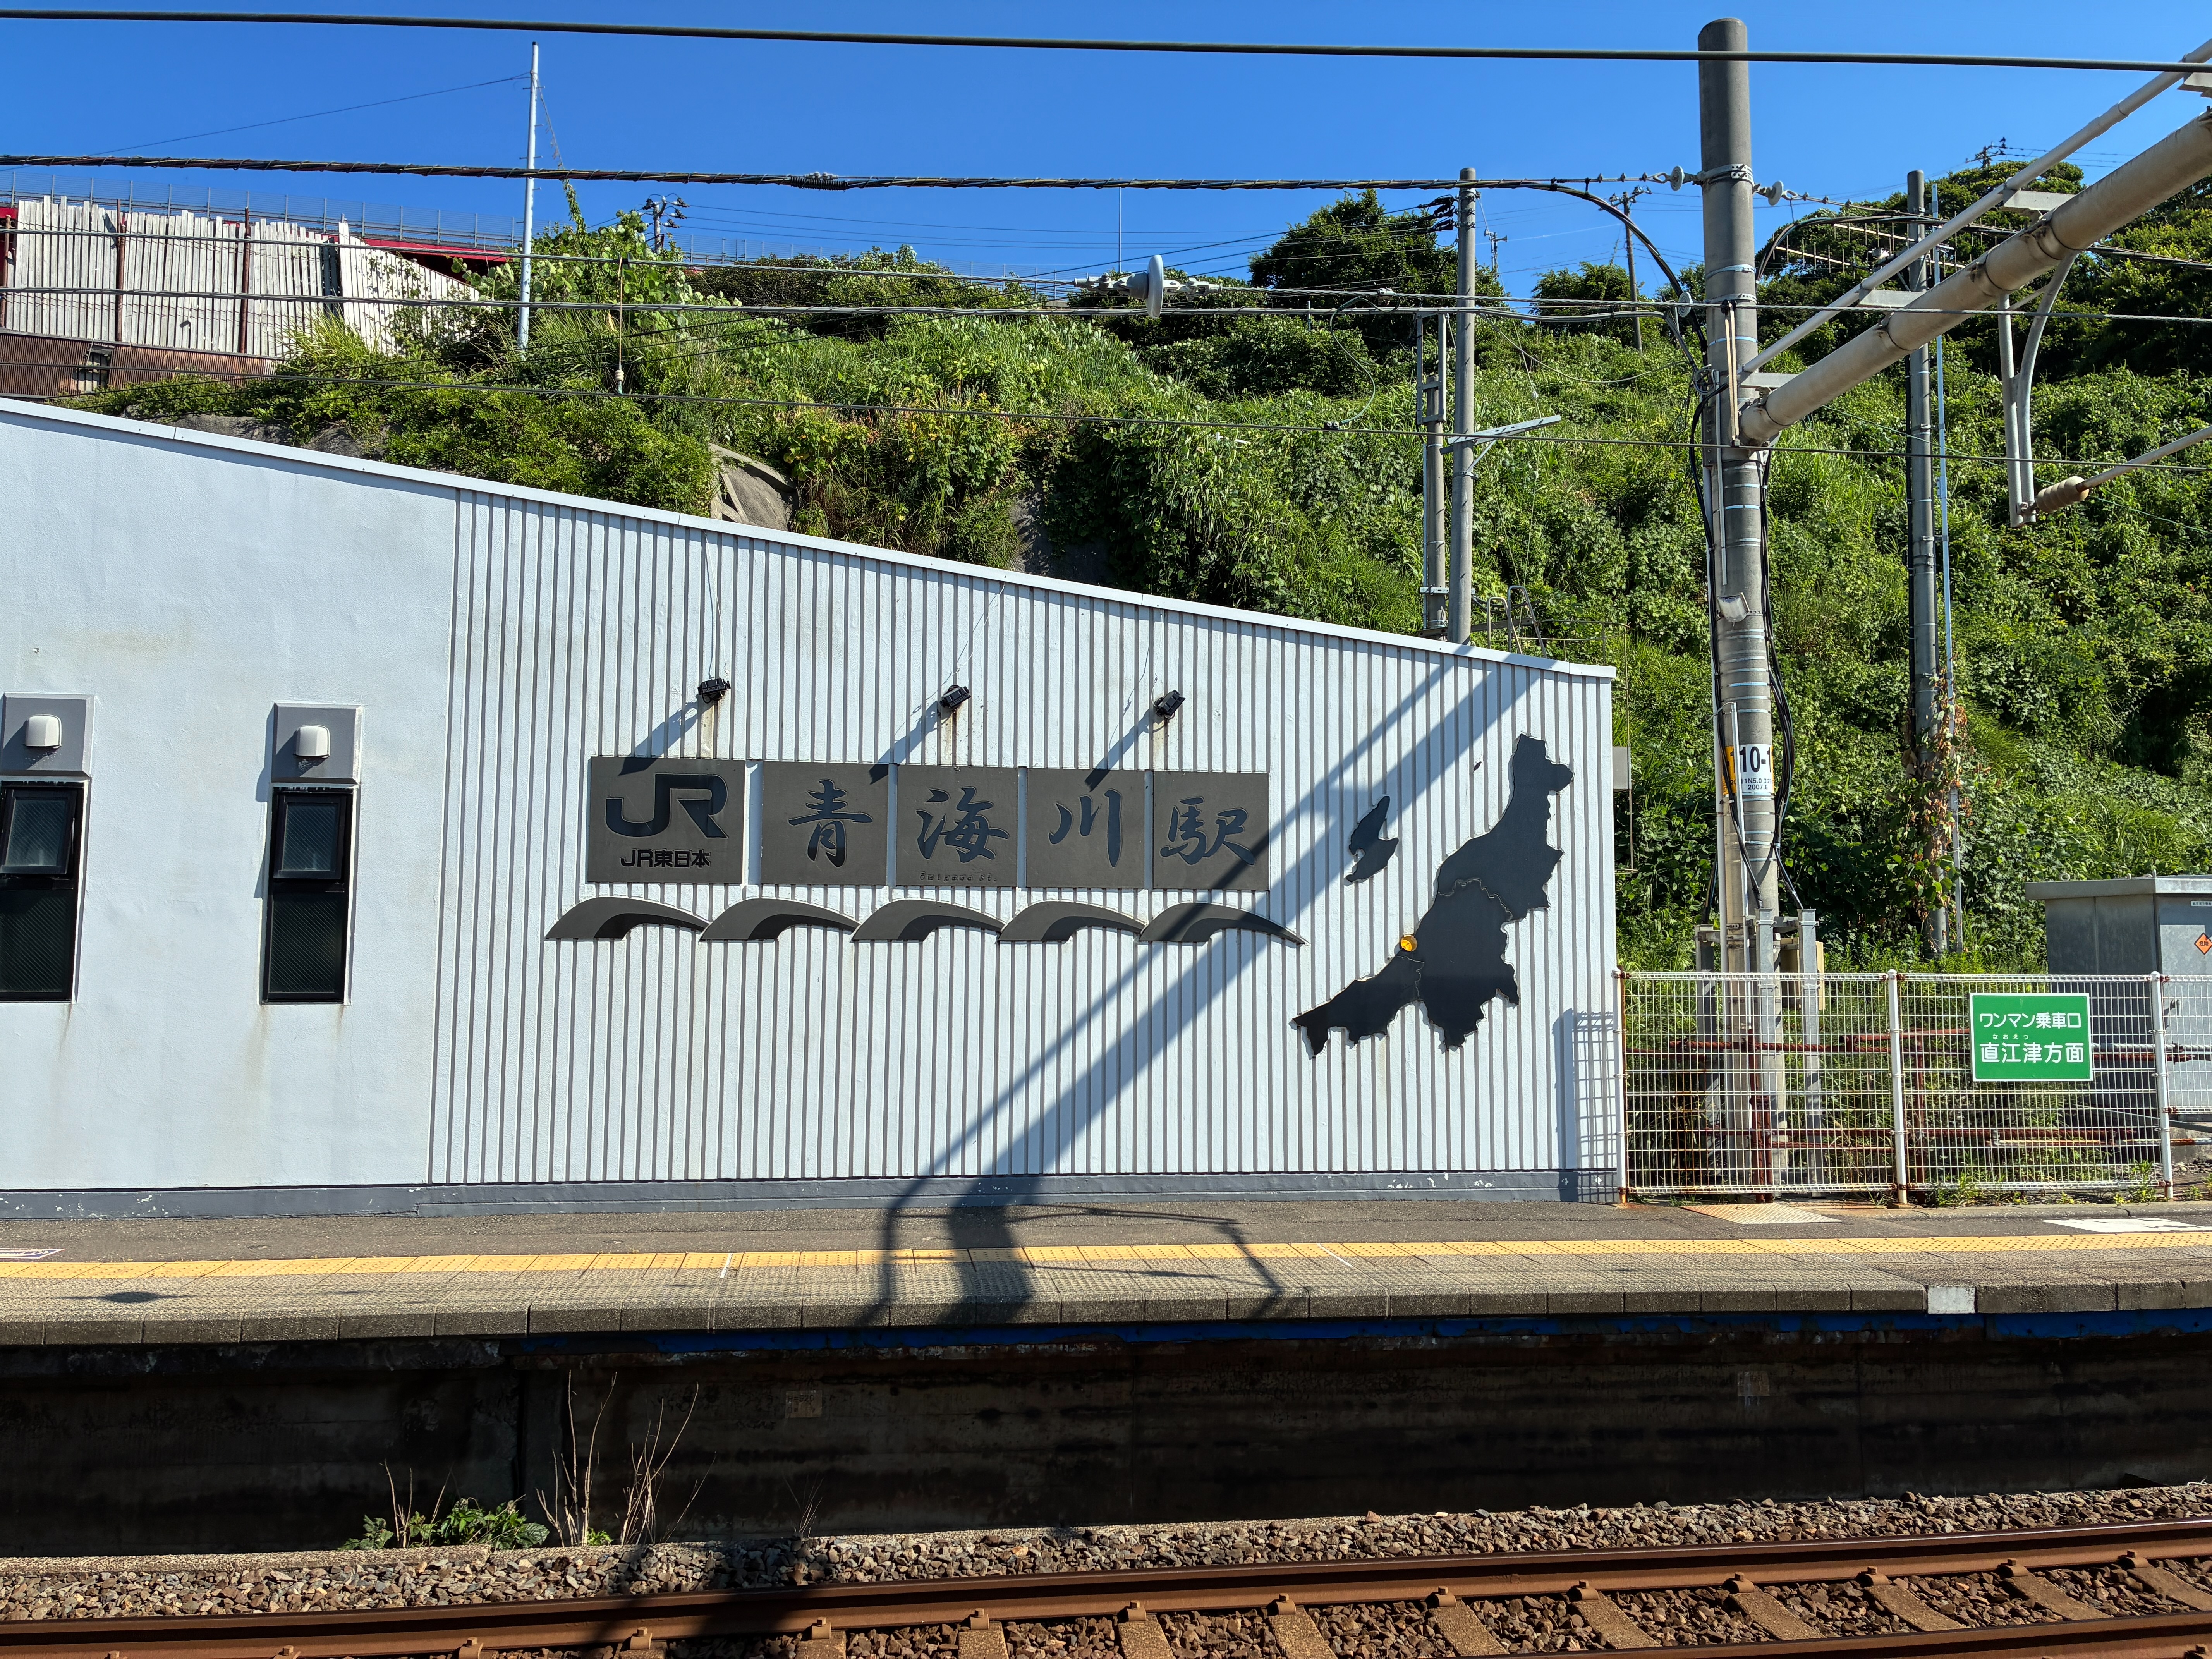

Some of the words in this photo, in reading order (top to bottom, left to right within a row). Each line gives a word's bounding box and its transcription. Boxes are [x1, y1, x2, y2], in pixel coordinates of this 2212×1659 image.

[605, 773, 729, 838] JR
[788, 778, 1256, 867] 青海川駅
[620, 849, 711, 868] JR東日本
[1980, 1012, 2081, 1029] ワンマン乗車口
[1979, 1041, 2084, 1063] 直江津方面
